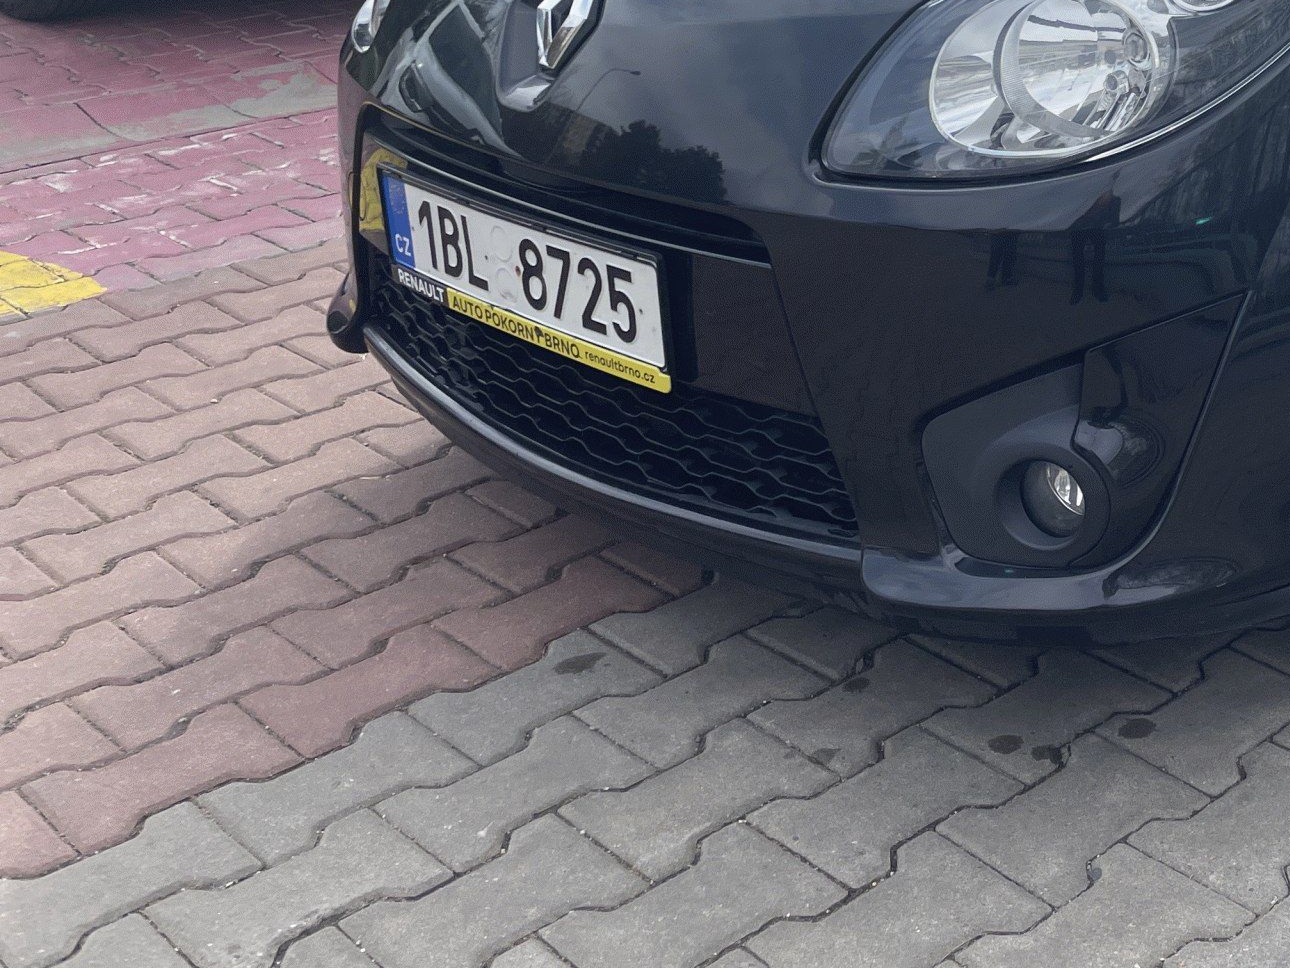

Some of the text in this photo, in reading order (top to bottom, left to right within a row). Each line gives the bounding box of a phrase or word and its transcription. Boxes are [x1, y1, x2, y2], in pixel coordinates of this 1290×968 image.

[394, 233, 412, 257] CZ
[418, 200, 637, 344] 1BL 8725
[398, 269, 445, 303] RENAULT
[452, 295, 483, 321] AUTO
[544, 333, 580, 360] BRNO
[584, 350, 656, 384] renaultbrno.cz
